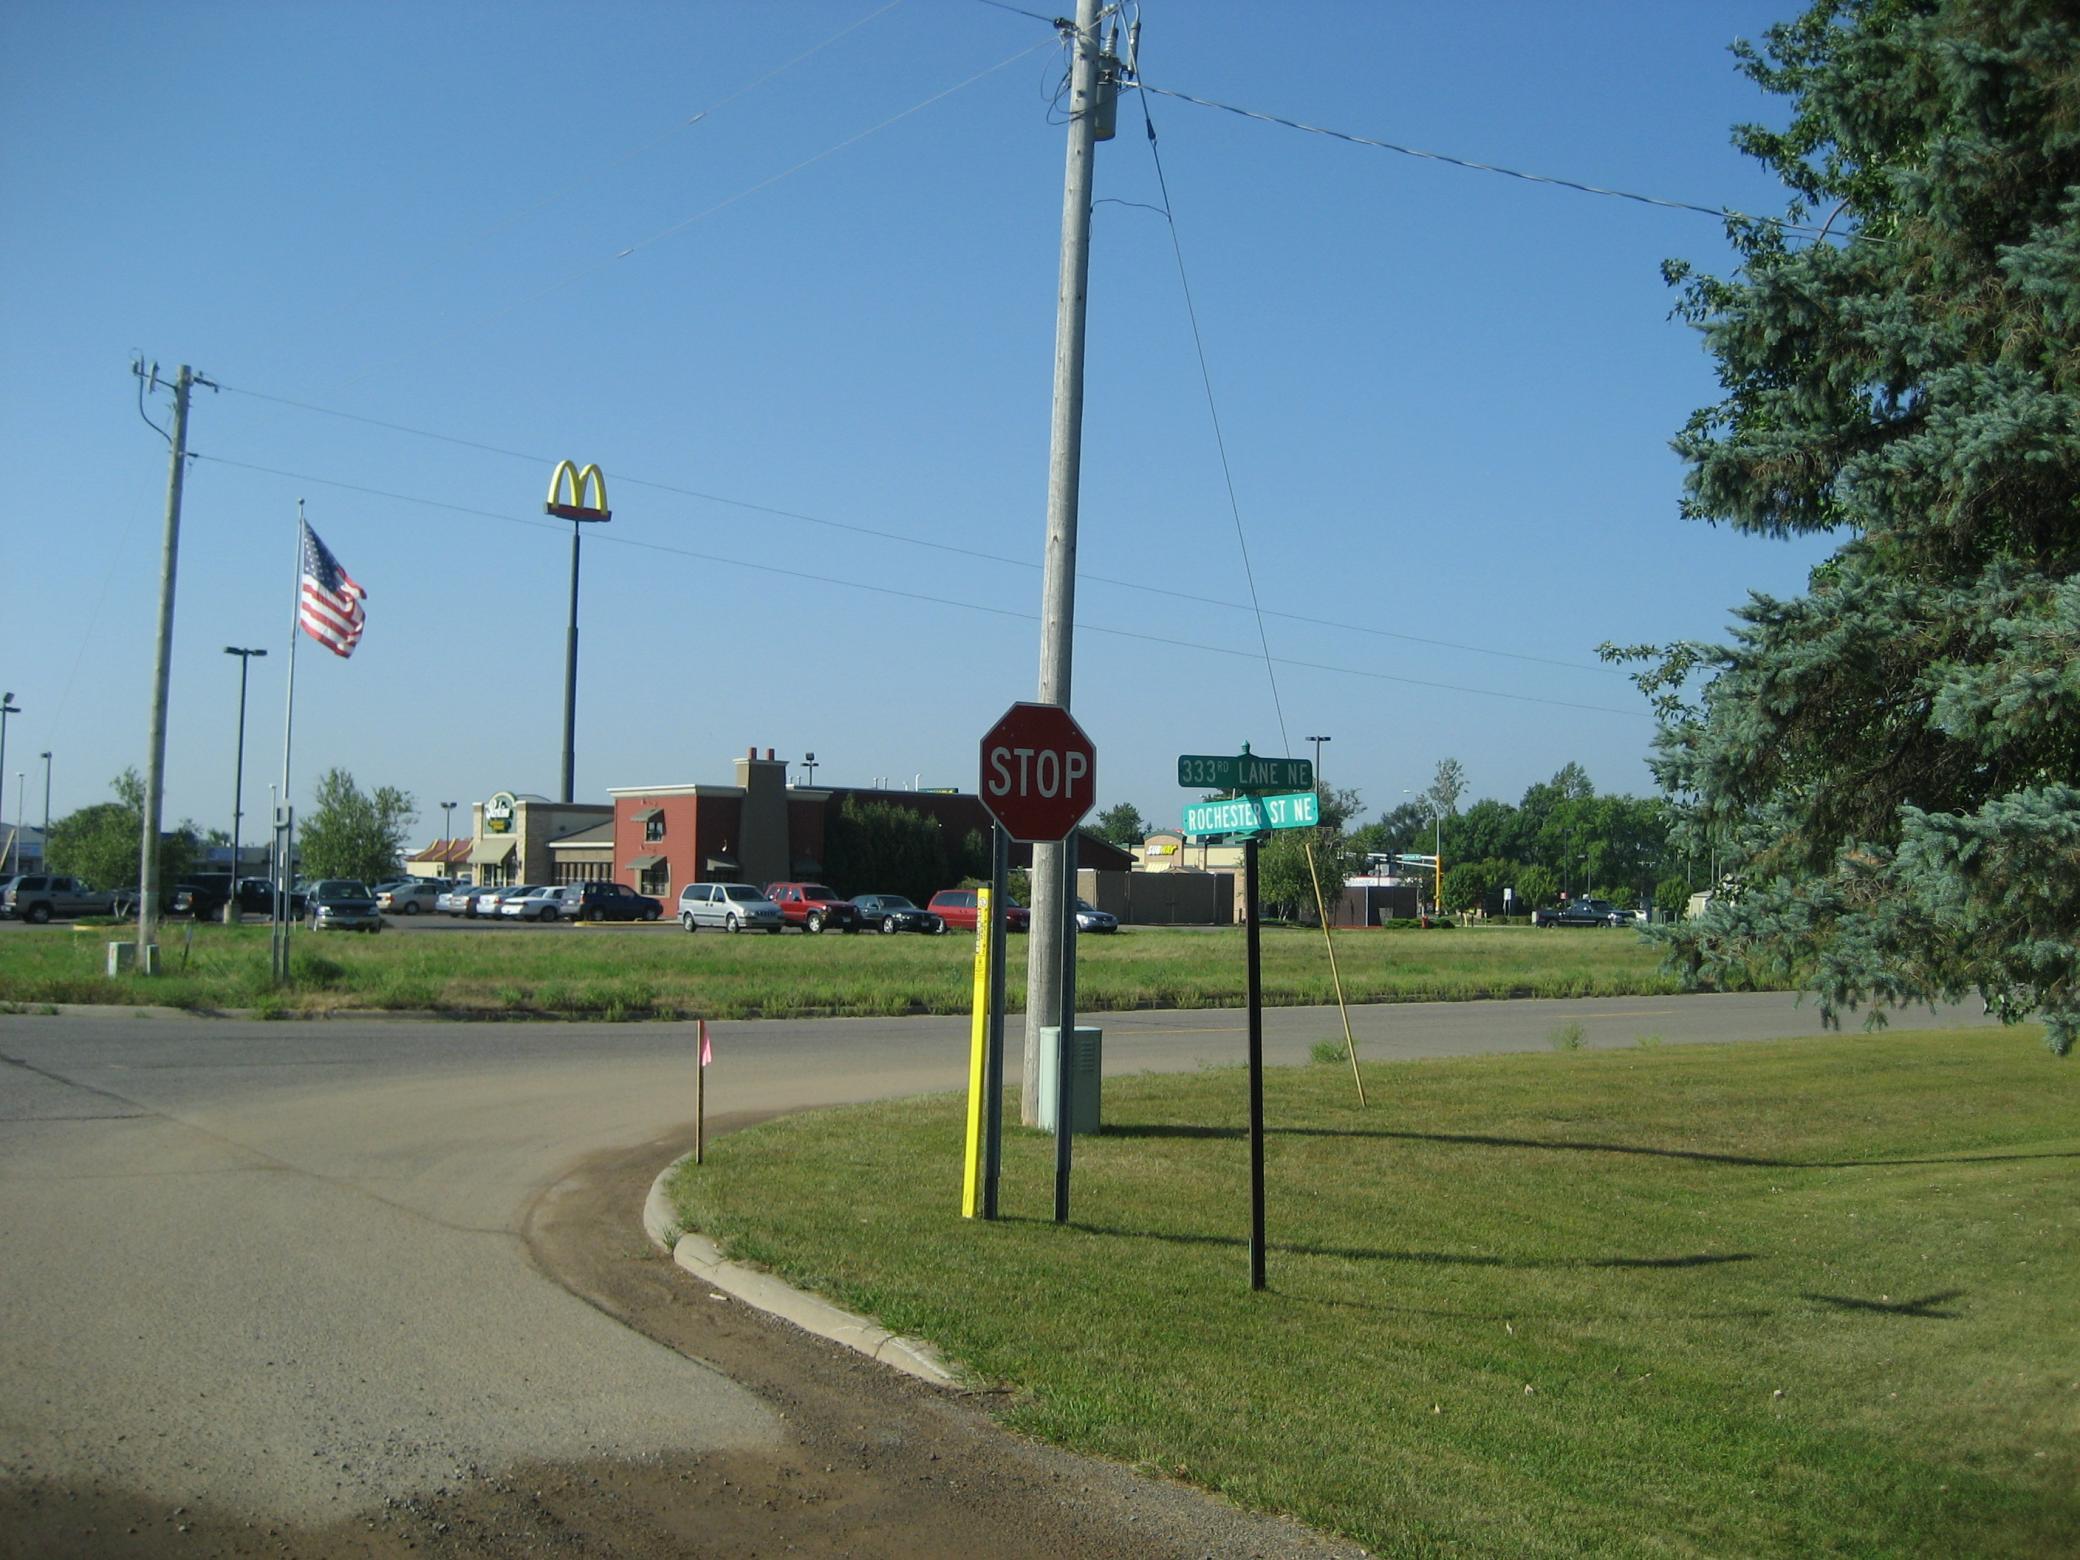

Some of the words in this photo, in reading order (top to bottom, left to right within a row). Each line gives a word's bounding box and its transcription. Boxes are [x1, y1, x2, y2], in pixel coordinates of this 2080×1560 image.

[988, 746, 1088, 799] STOP
[1238, 761, 1279, 784] LANE
[1287, 763, 1309, 785] NE
[1187, 803, 1263, 831] ROCHESTER
[1269, 800, 1286, 823] ST
[1293, 797, 1313, 821] NE
